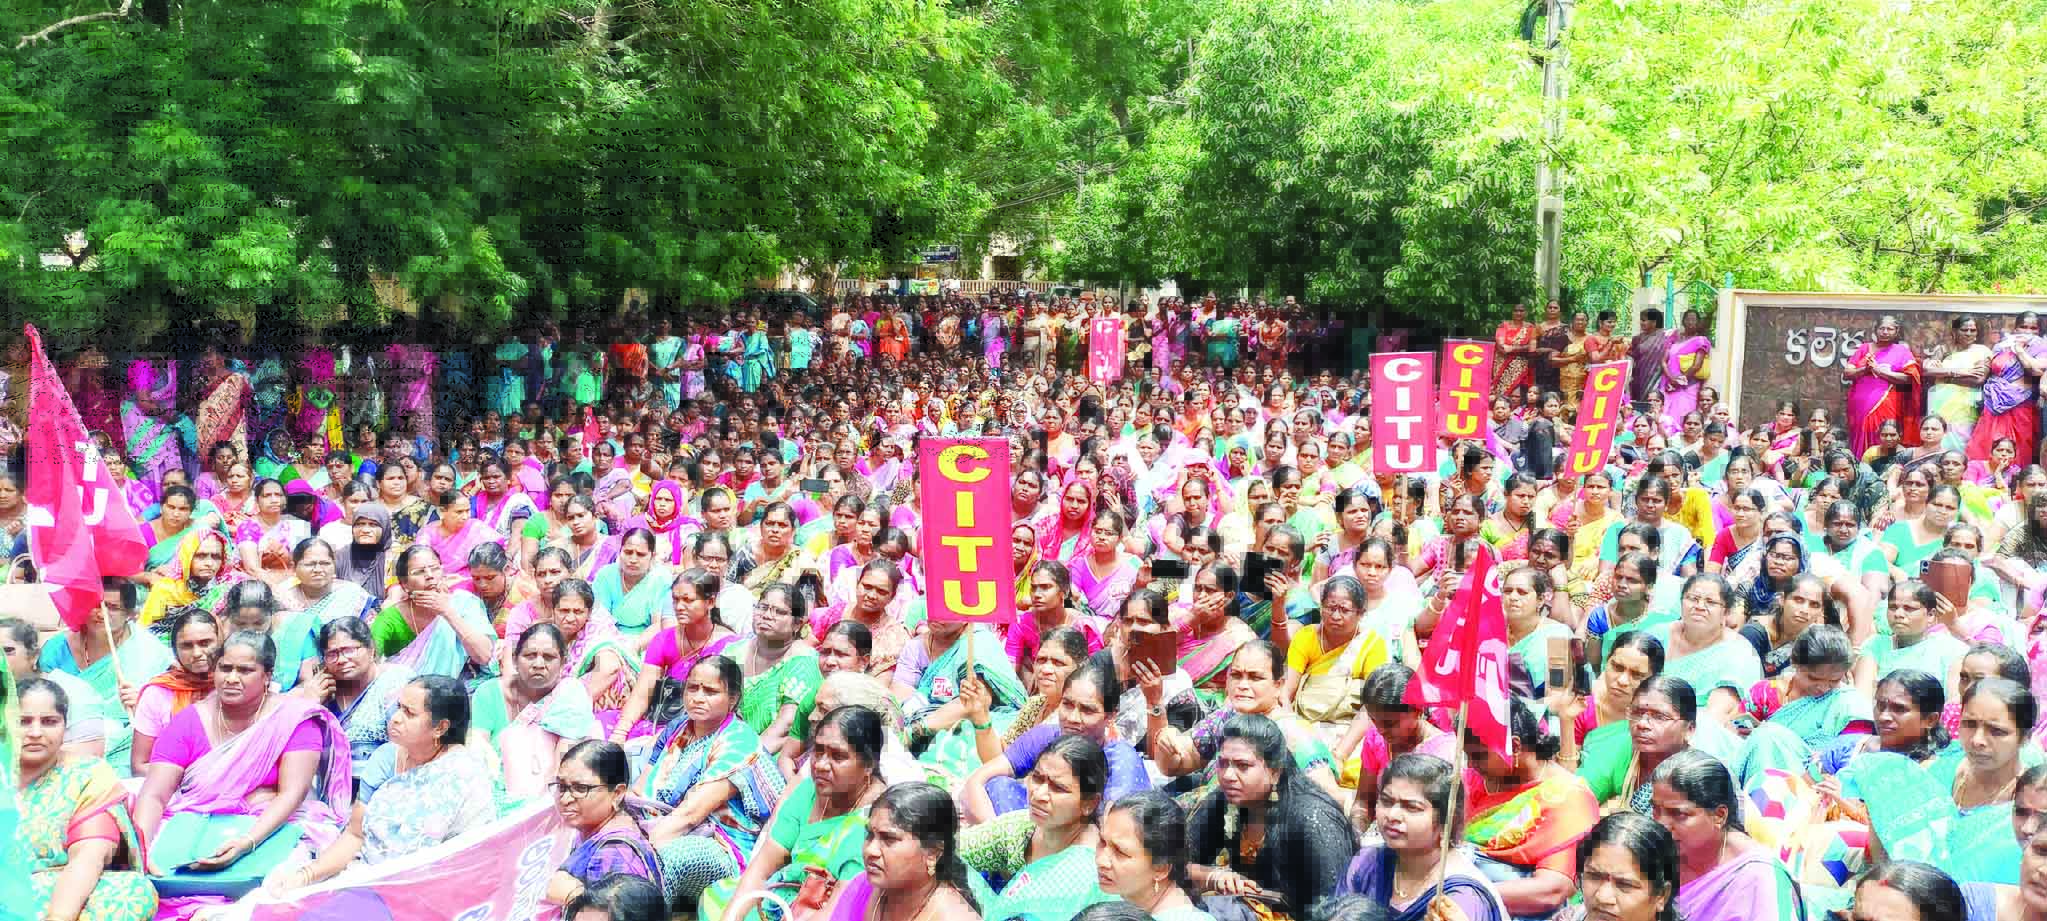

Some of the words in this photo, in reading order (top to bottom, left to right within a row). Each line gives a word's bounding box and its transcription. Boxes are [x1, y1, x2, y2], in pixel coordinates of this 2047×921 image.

[1383, 358, 1423, 470] CITU
[1447, 344, 1484, 435] CITU
[1573, 367, 1617, 473] CITU
[937, 444, 997, 616] CITU
